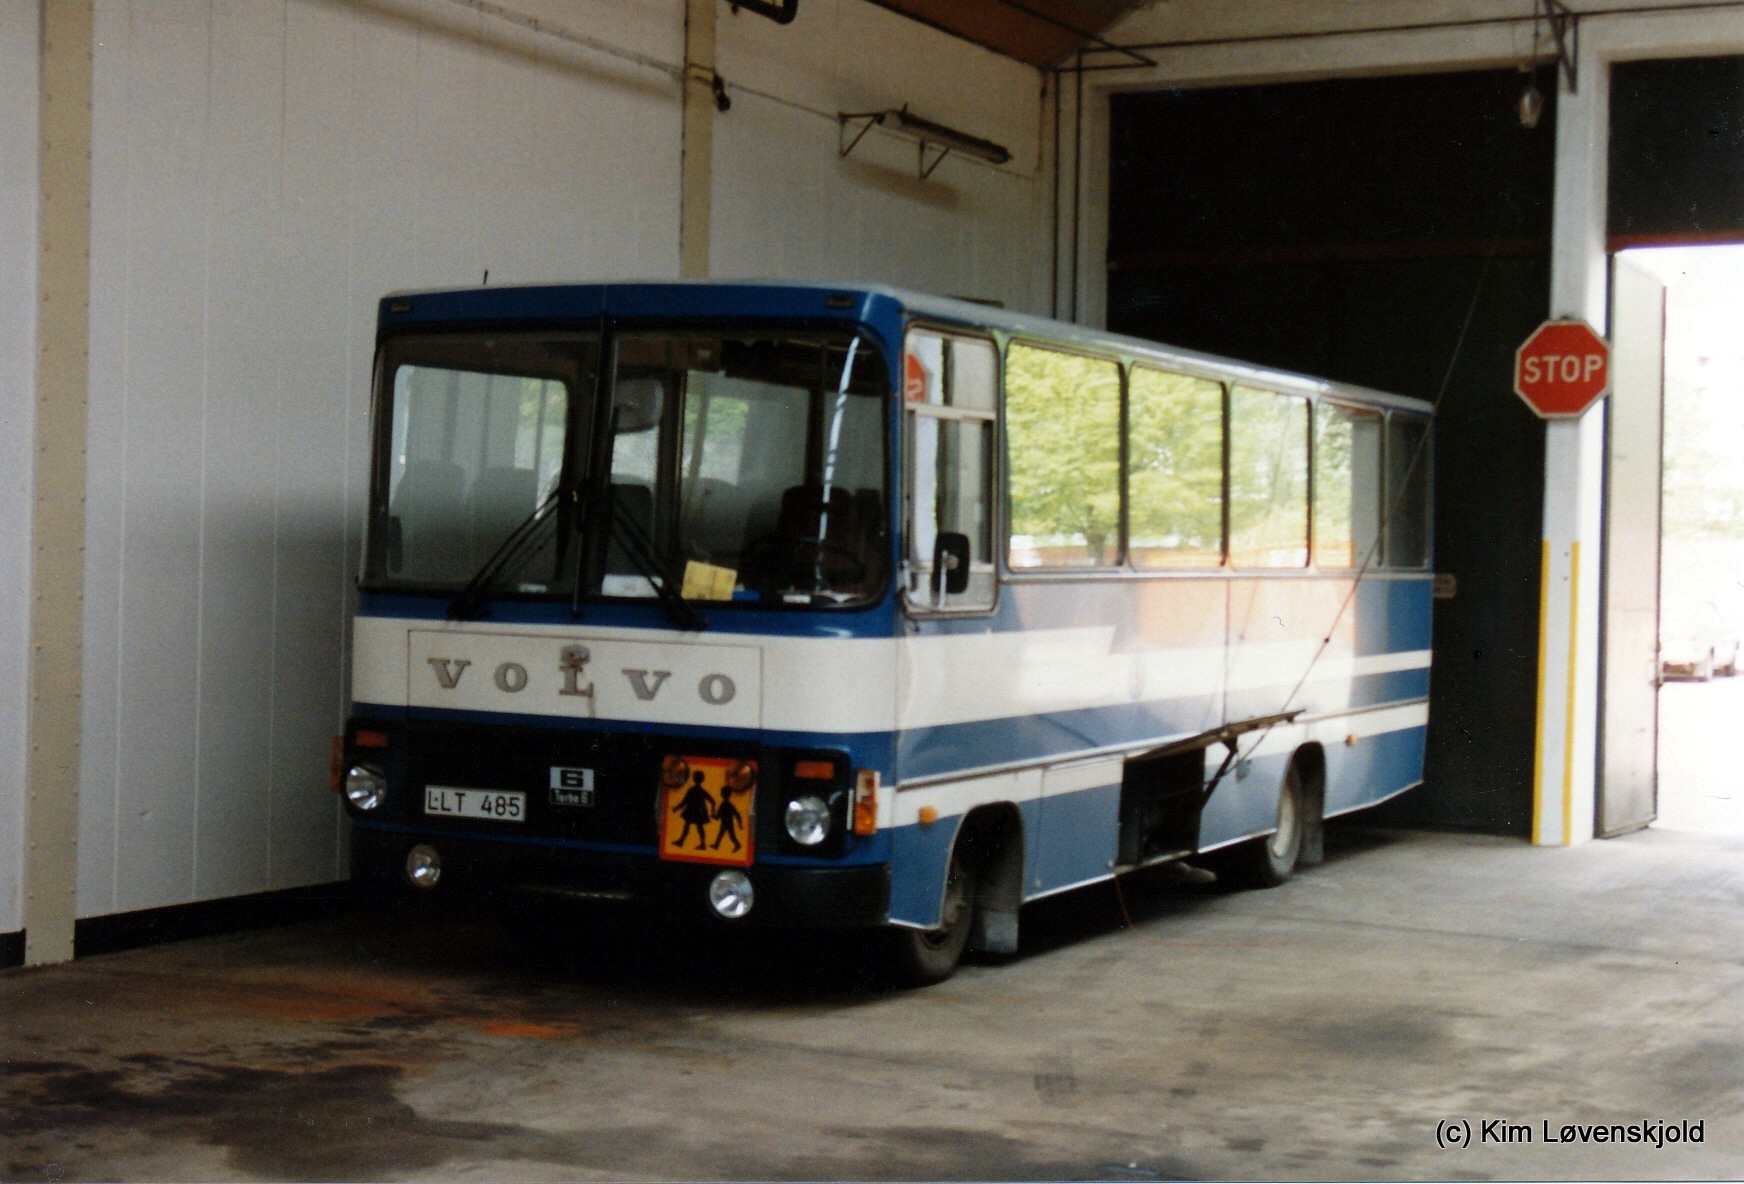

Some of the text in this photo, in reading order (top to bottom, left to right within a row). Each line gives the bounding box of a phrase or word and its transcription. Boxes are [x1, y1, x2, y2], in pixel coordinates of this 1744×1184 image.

[1524, 354, 1603, 383] STOP
[428, 657, 736, 705] VOLVO
[427, 791, 520, 817] LLT 485
